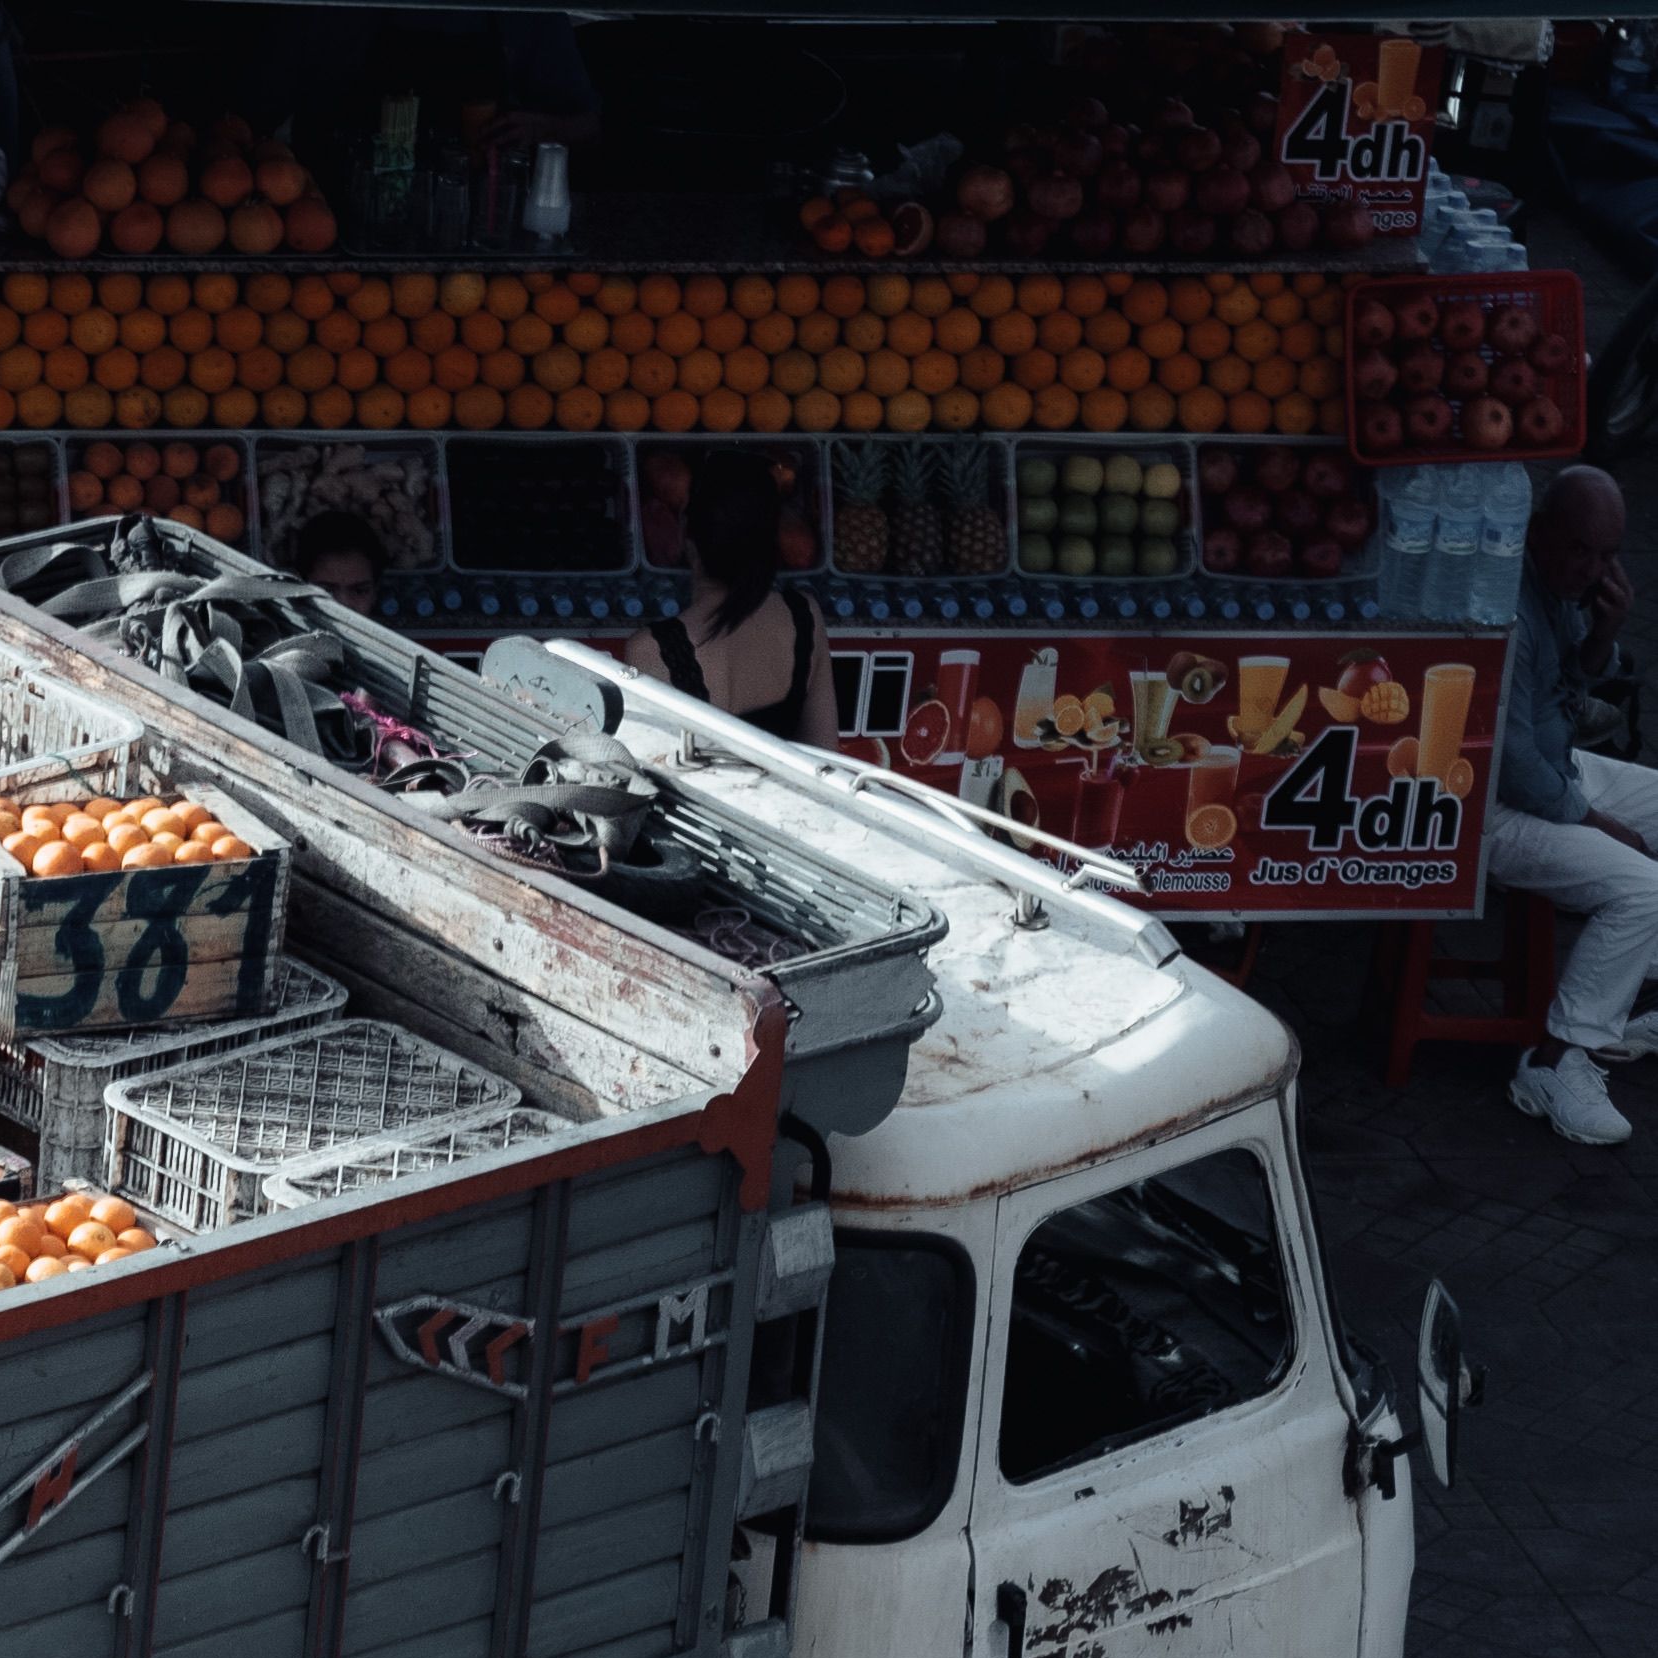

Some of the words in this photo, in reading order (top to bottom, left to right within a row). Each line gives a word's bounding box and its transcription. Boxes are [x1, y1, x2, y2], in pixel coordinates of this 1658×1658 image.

[1282, 77, 1426, 182] 4dh
[1293, 183, 1353, 206] البرتقا
[1261, 725, 1464, 853] 4dh
[1168, 846, 1236, 868] عصير
[1251, 859, 1302, 885] Jus
[15, 858, 278, 1032] 381
[25, 1449, 80, 1530] H
